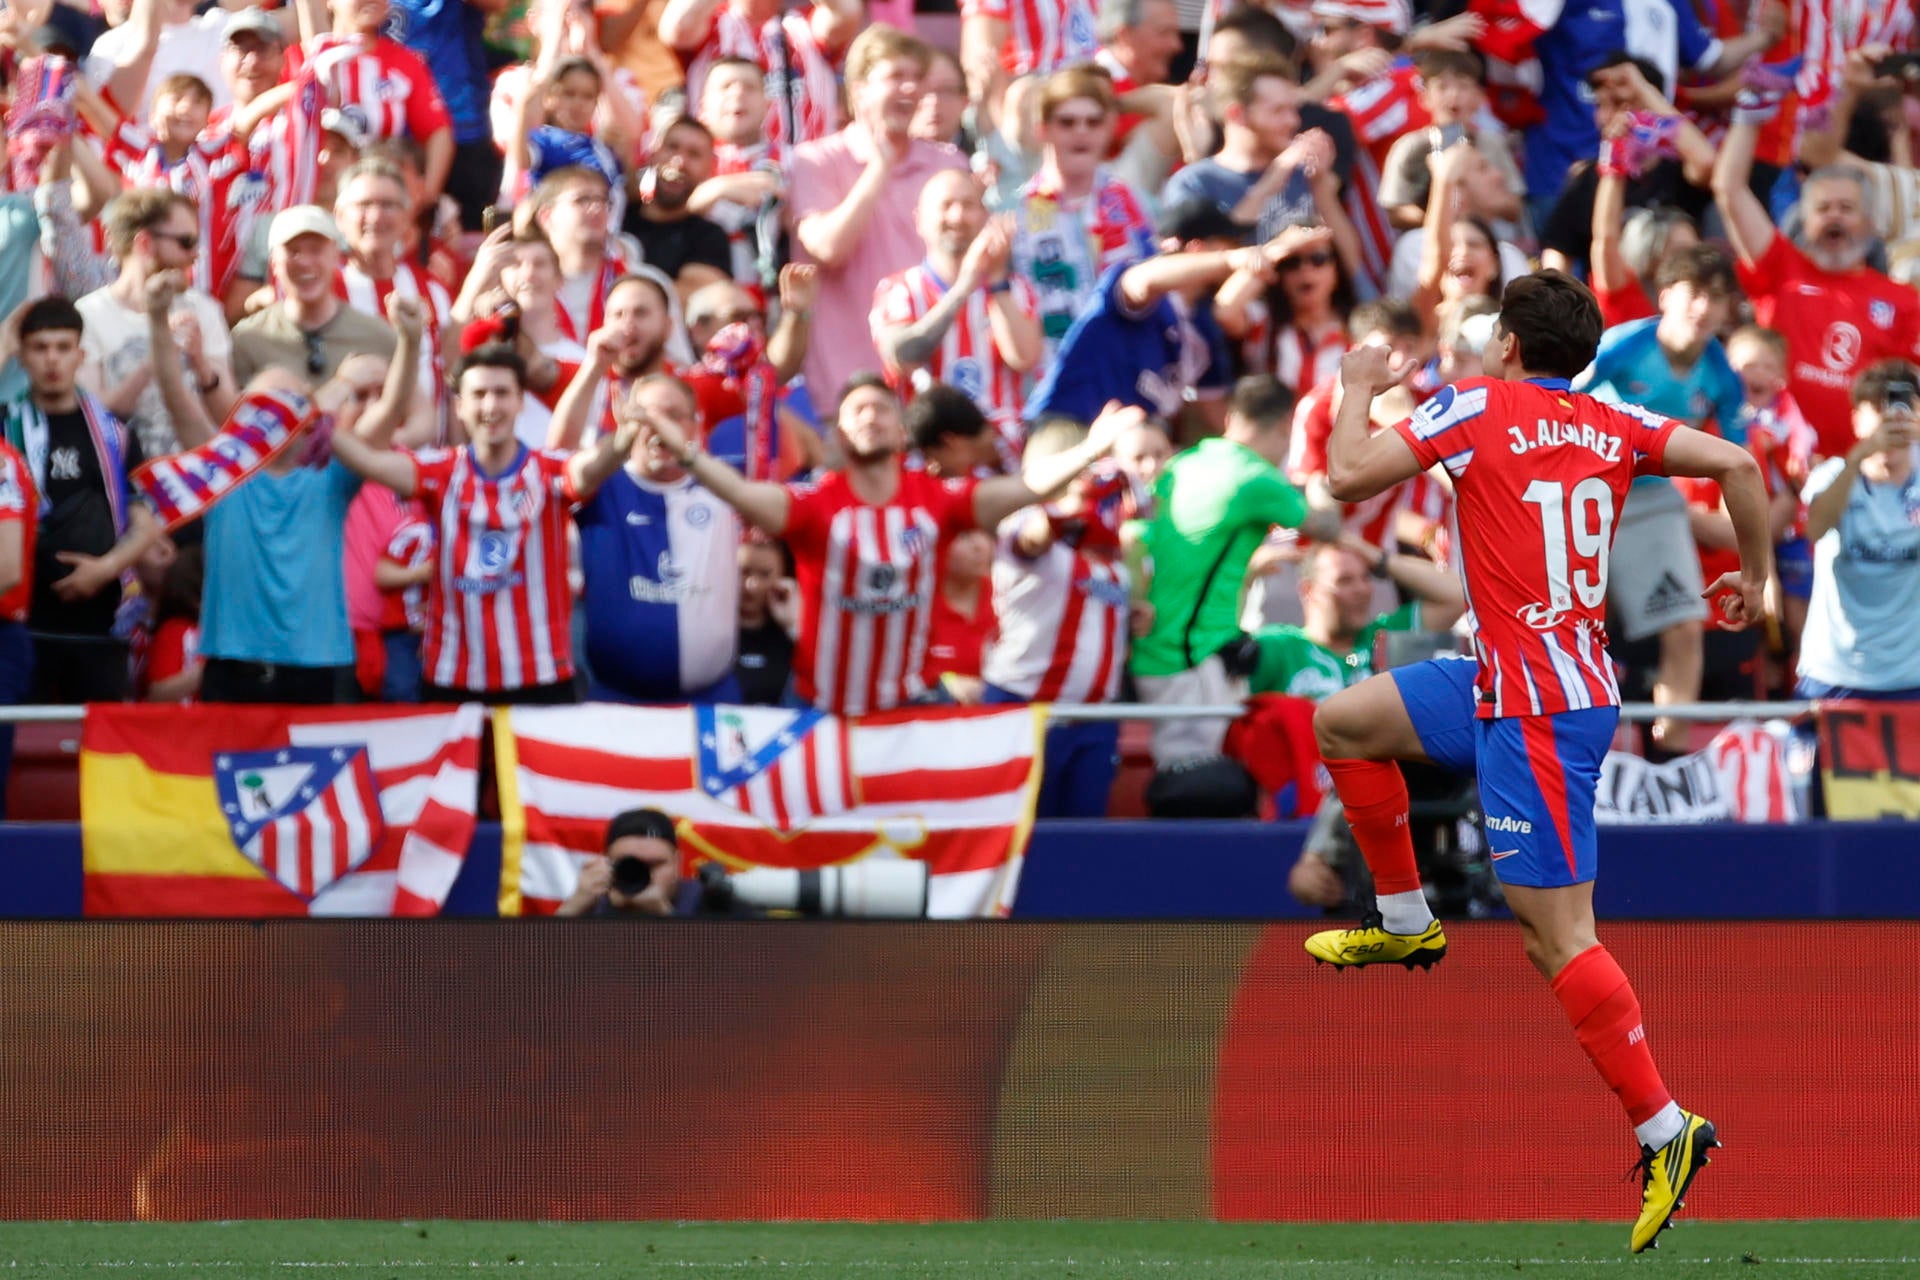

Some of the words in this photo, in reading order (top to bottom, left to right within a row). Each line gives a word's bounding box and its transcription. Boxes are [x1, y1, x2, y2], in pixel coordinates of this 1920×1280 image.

[1520, 476, 1615, 612] 19
[1484, 813, 1532, 835] mAve
[1339, 942, 1385, 958] F50
